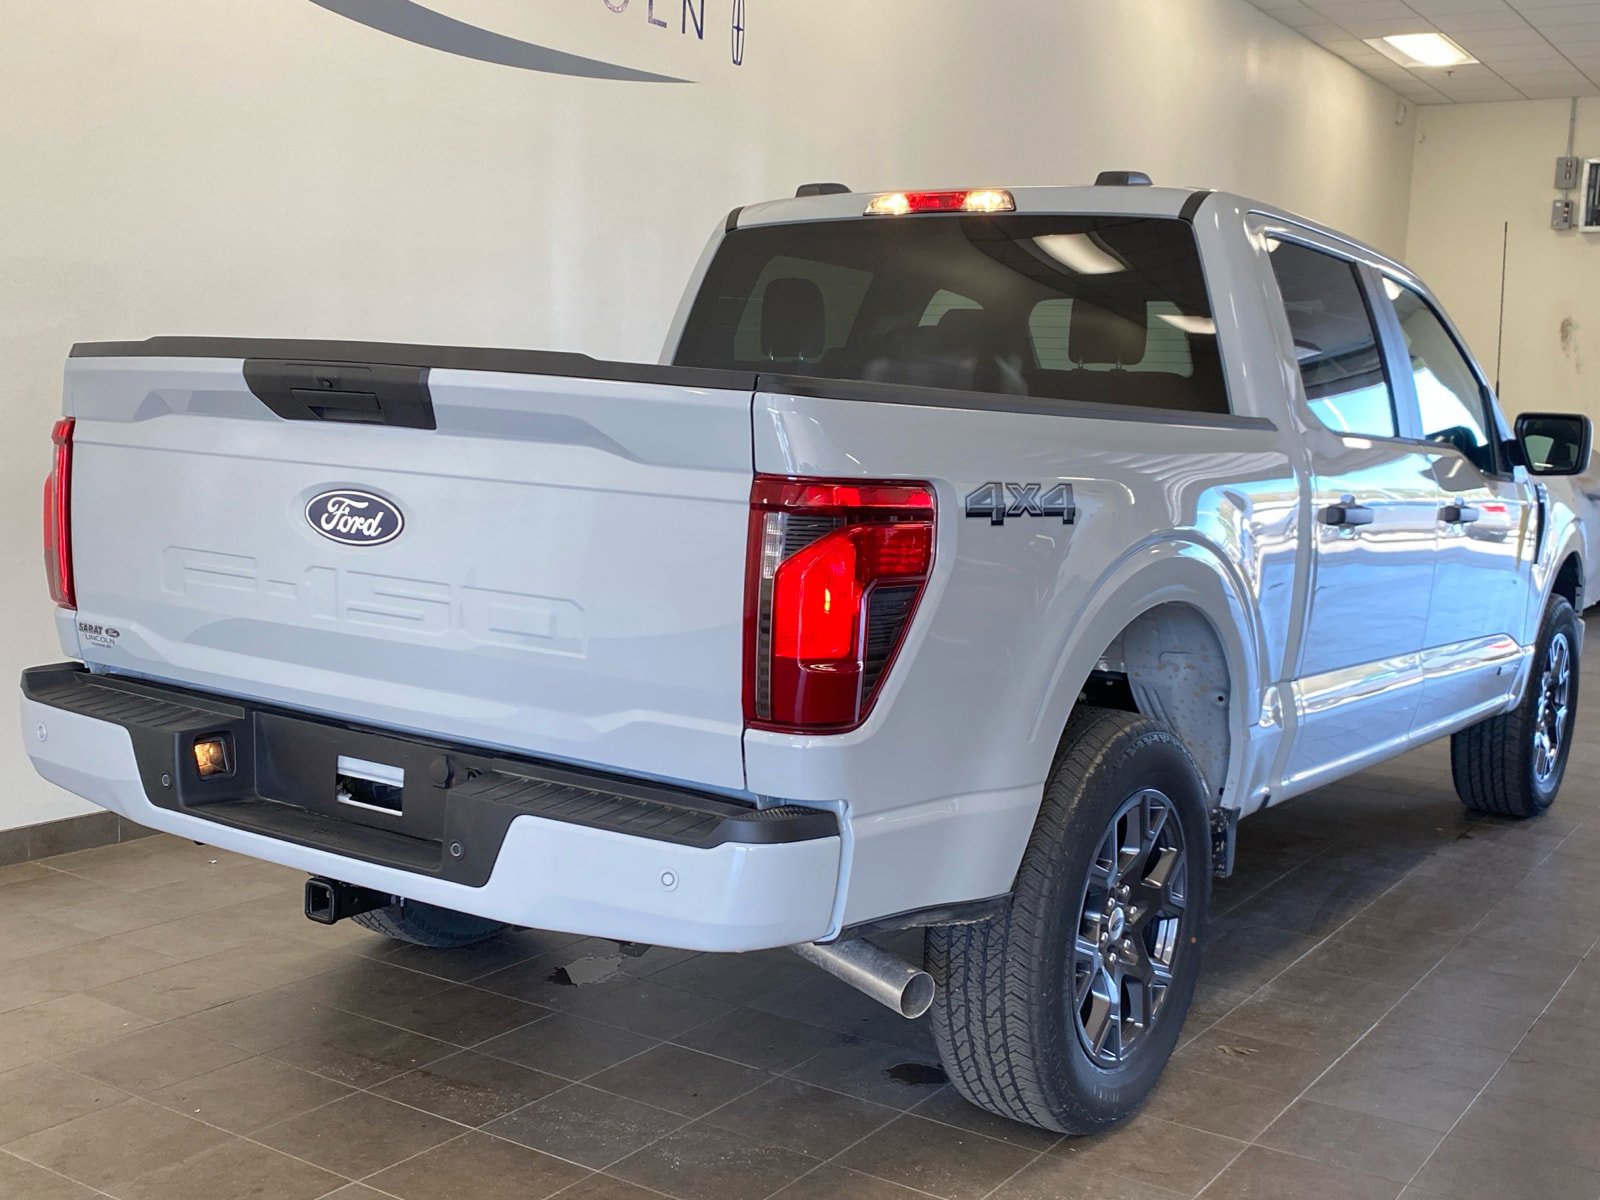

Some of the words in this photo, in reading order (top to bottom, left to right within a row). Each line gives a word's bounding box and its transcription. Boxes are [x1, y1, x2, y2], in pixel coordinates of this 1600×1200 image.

[320, 496, 384, 537] Ford
[162, 545, 588, 659] F-150
[85, 634, 115, 645] LINCOLN
